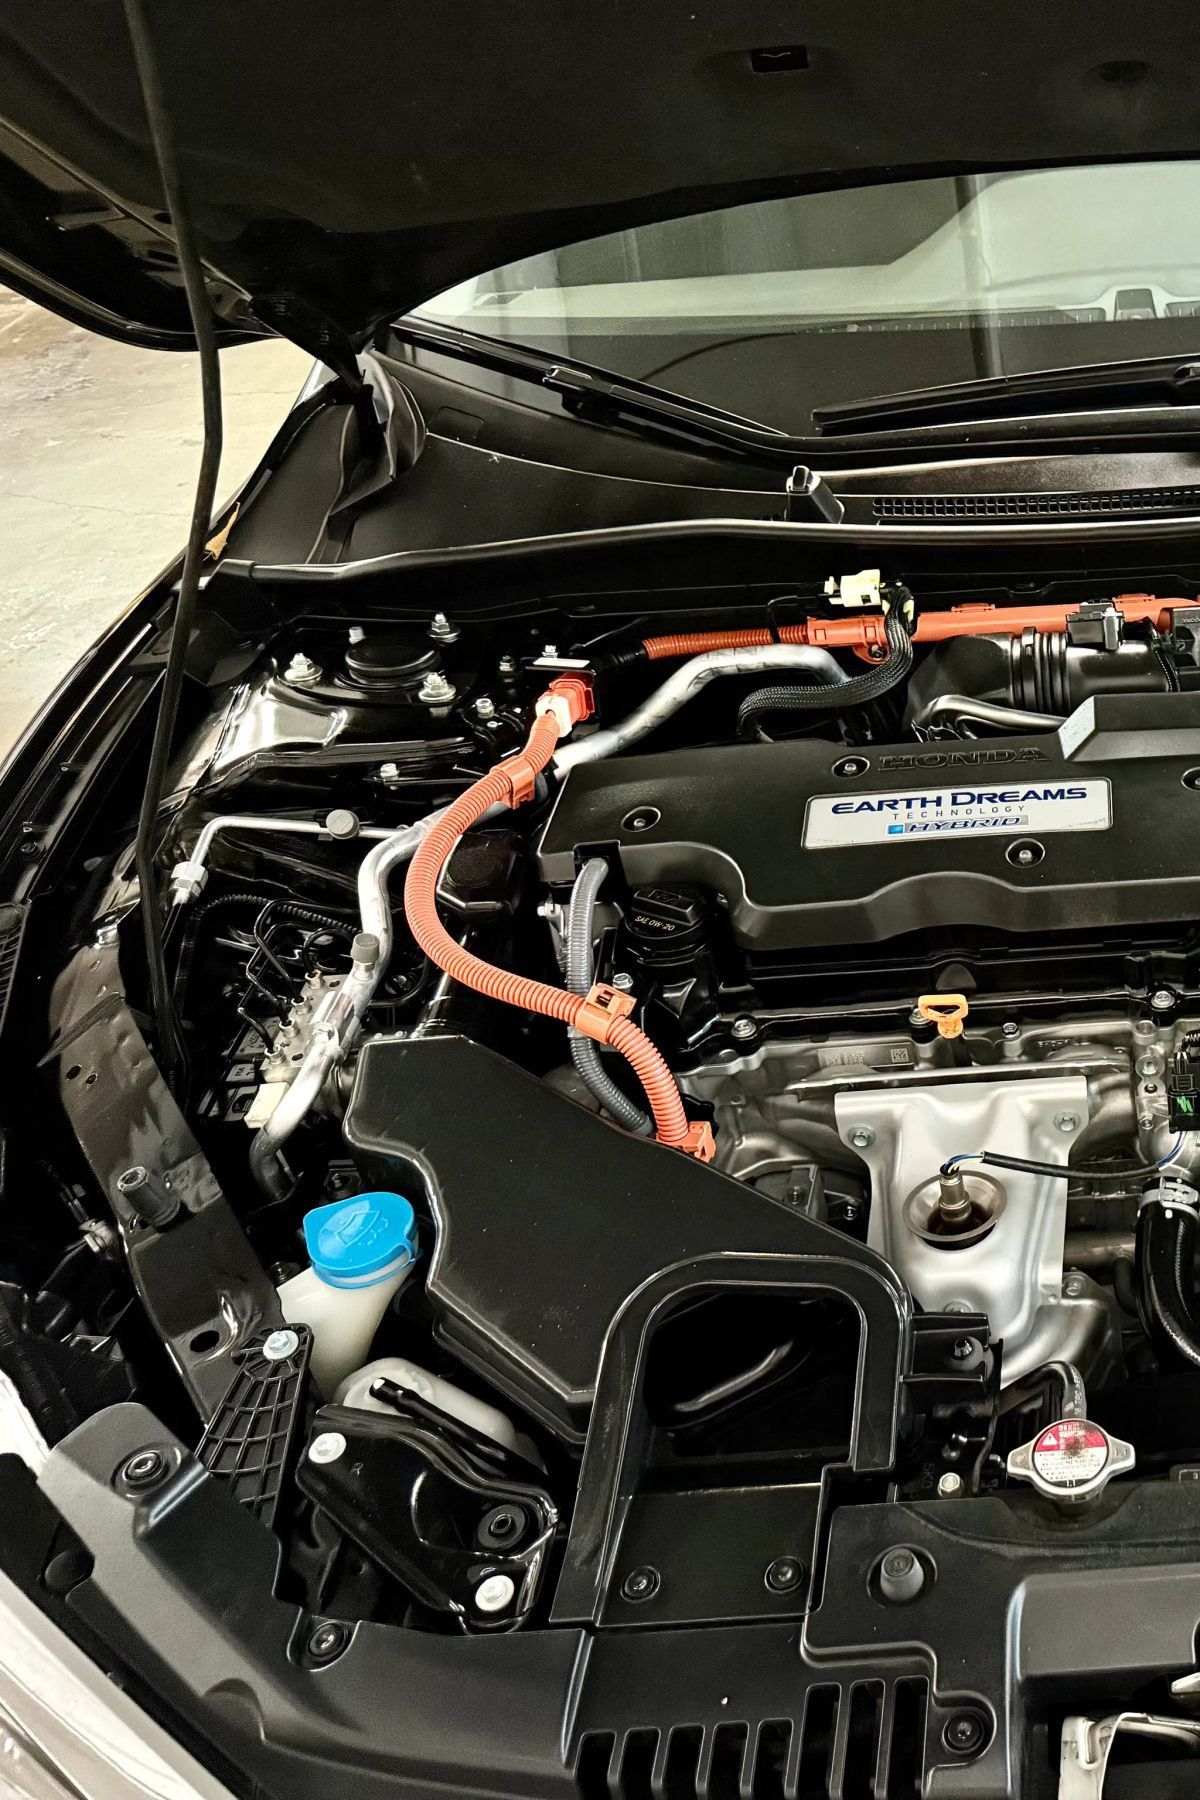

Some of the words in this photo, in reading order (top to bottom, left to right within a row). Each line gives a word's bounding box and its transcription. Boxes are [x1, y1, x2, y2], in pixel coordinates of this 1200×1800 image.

[878, 746, 1053, 771] HONDA
[831, 795, 942, 815] EARTH
[950, 787, 1088, 808] DREAMS
[892, 805, 1025, 820] TECHNOLOGY
[909, 817, 1021, 832] HYBRID
[634, 915, 649, 925] SAE
